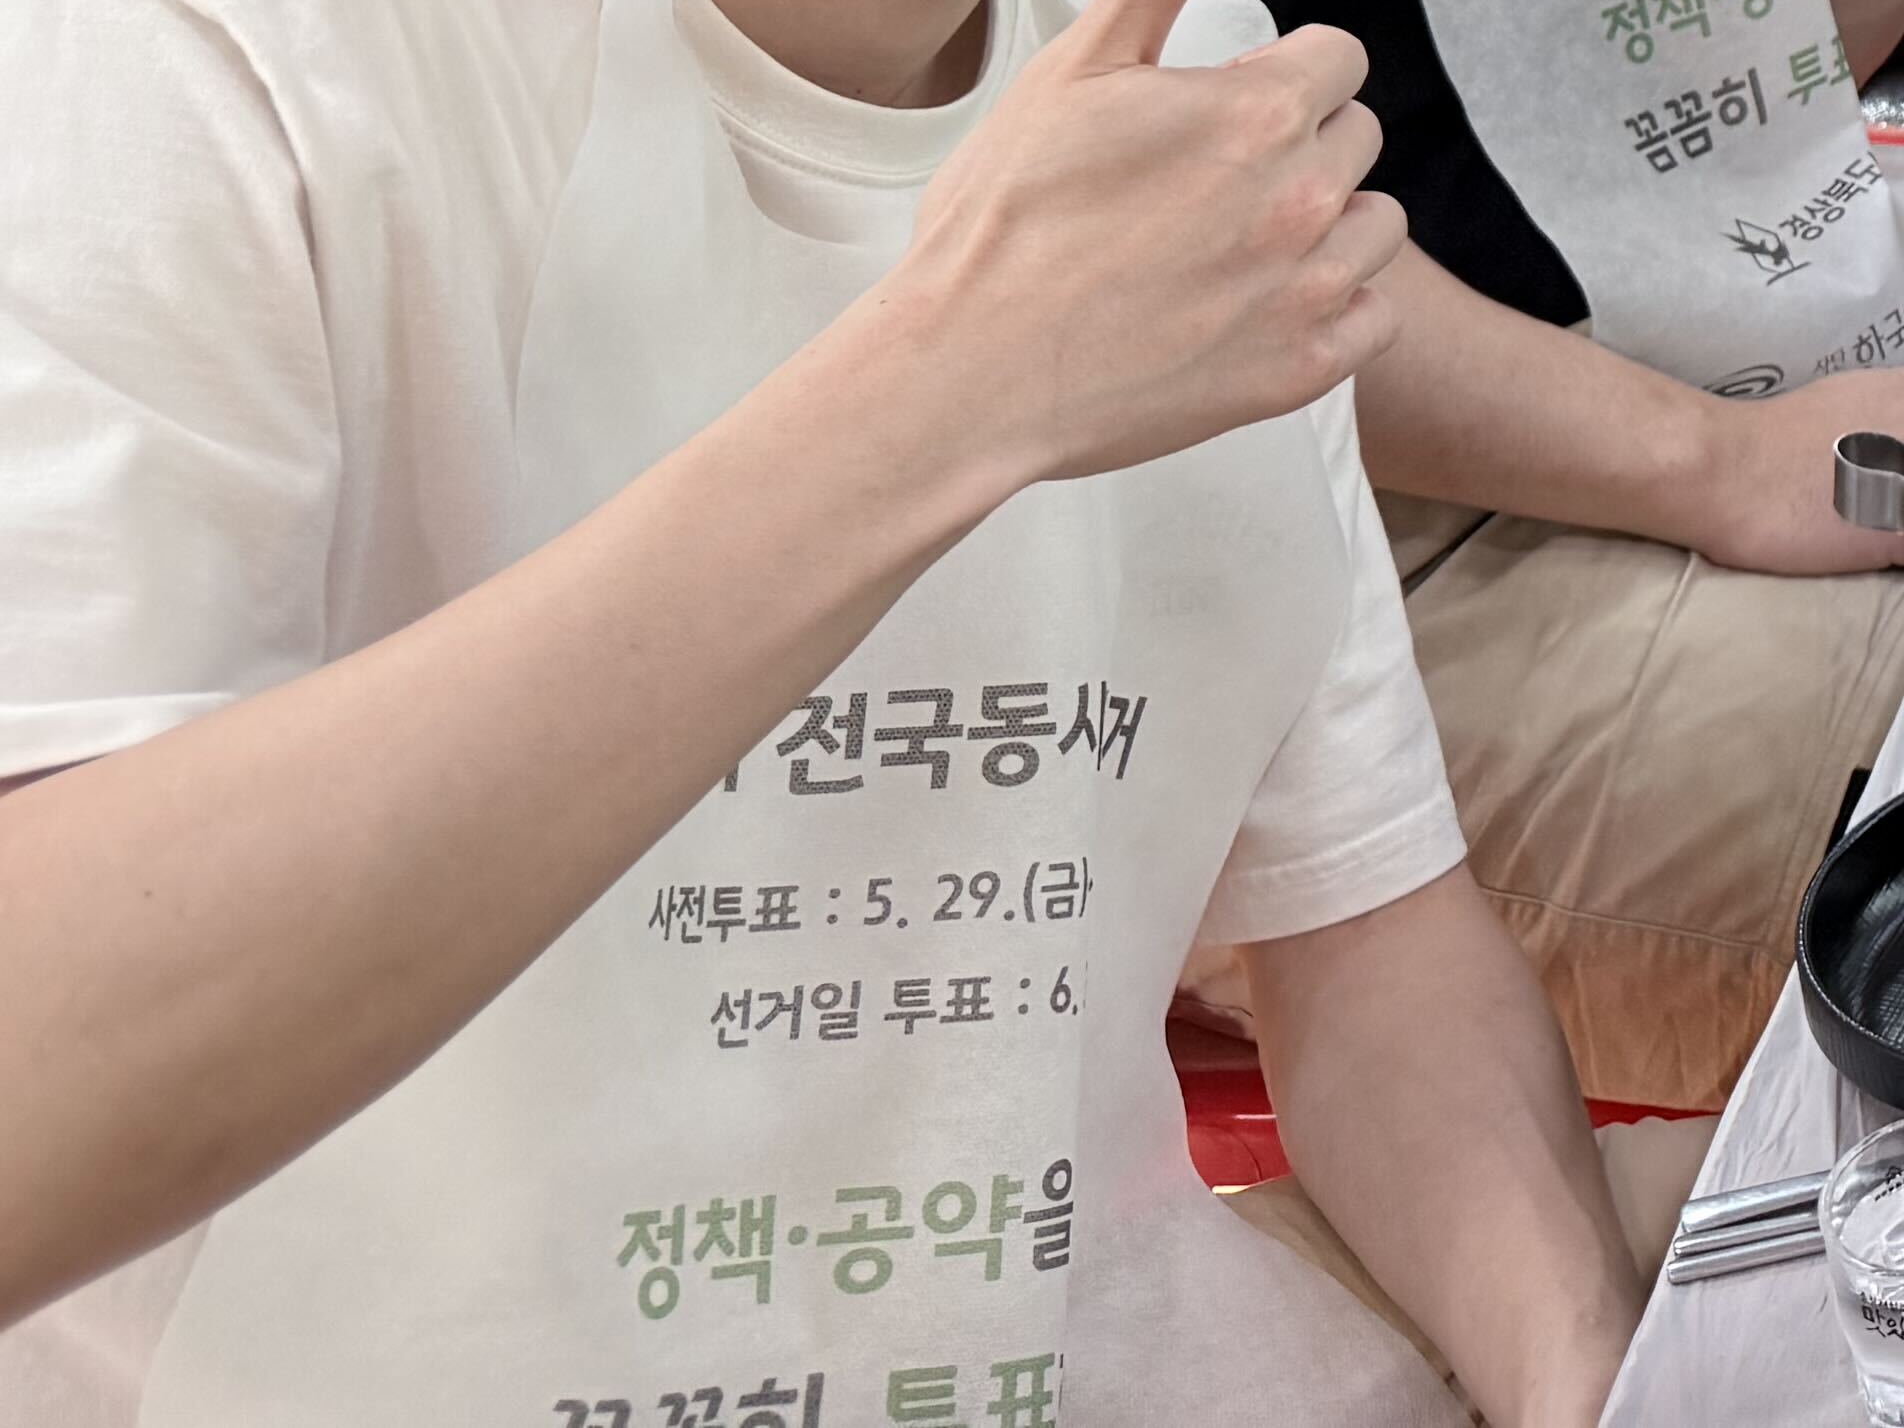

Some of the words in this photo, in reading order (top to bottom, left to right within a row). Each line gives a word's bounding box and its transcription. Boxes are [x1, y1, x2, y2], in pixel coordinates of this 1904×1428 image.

[1623, 67, 1768, 174] 꼼꼼히
[648, 884, 801, 944] 사전투표
[863, 877, 908, 929] 5.
[710, 980, 862, 1048] 선거일
[883, 976, 995, 1035] 투표
[616, 1157, 1074, 1320] 정책·공약을
